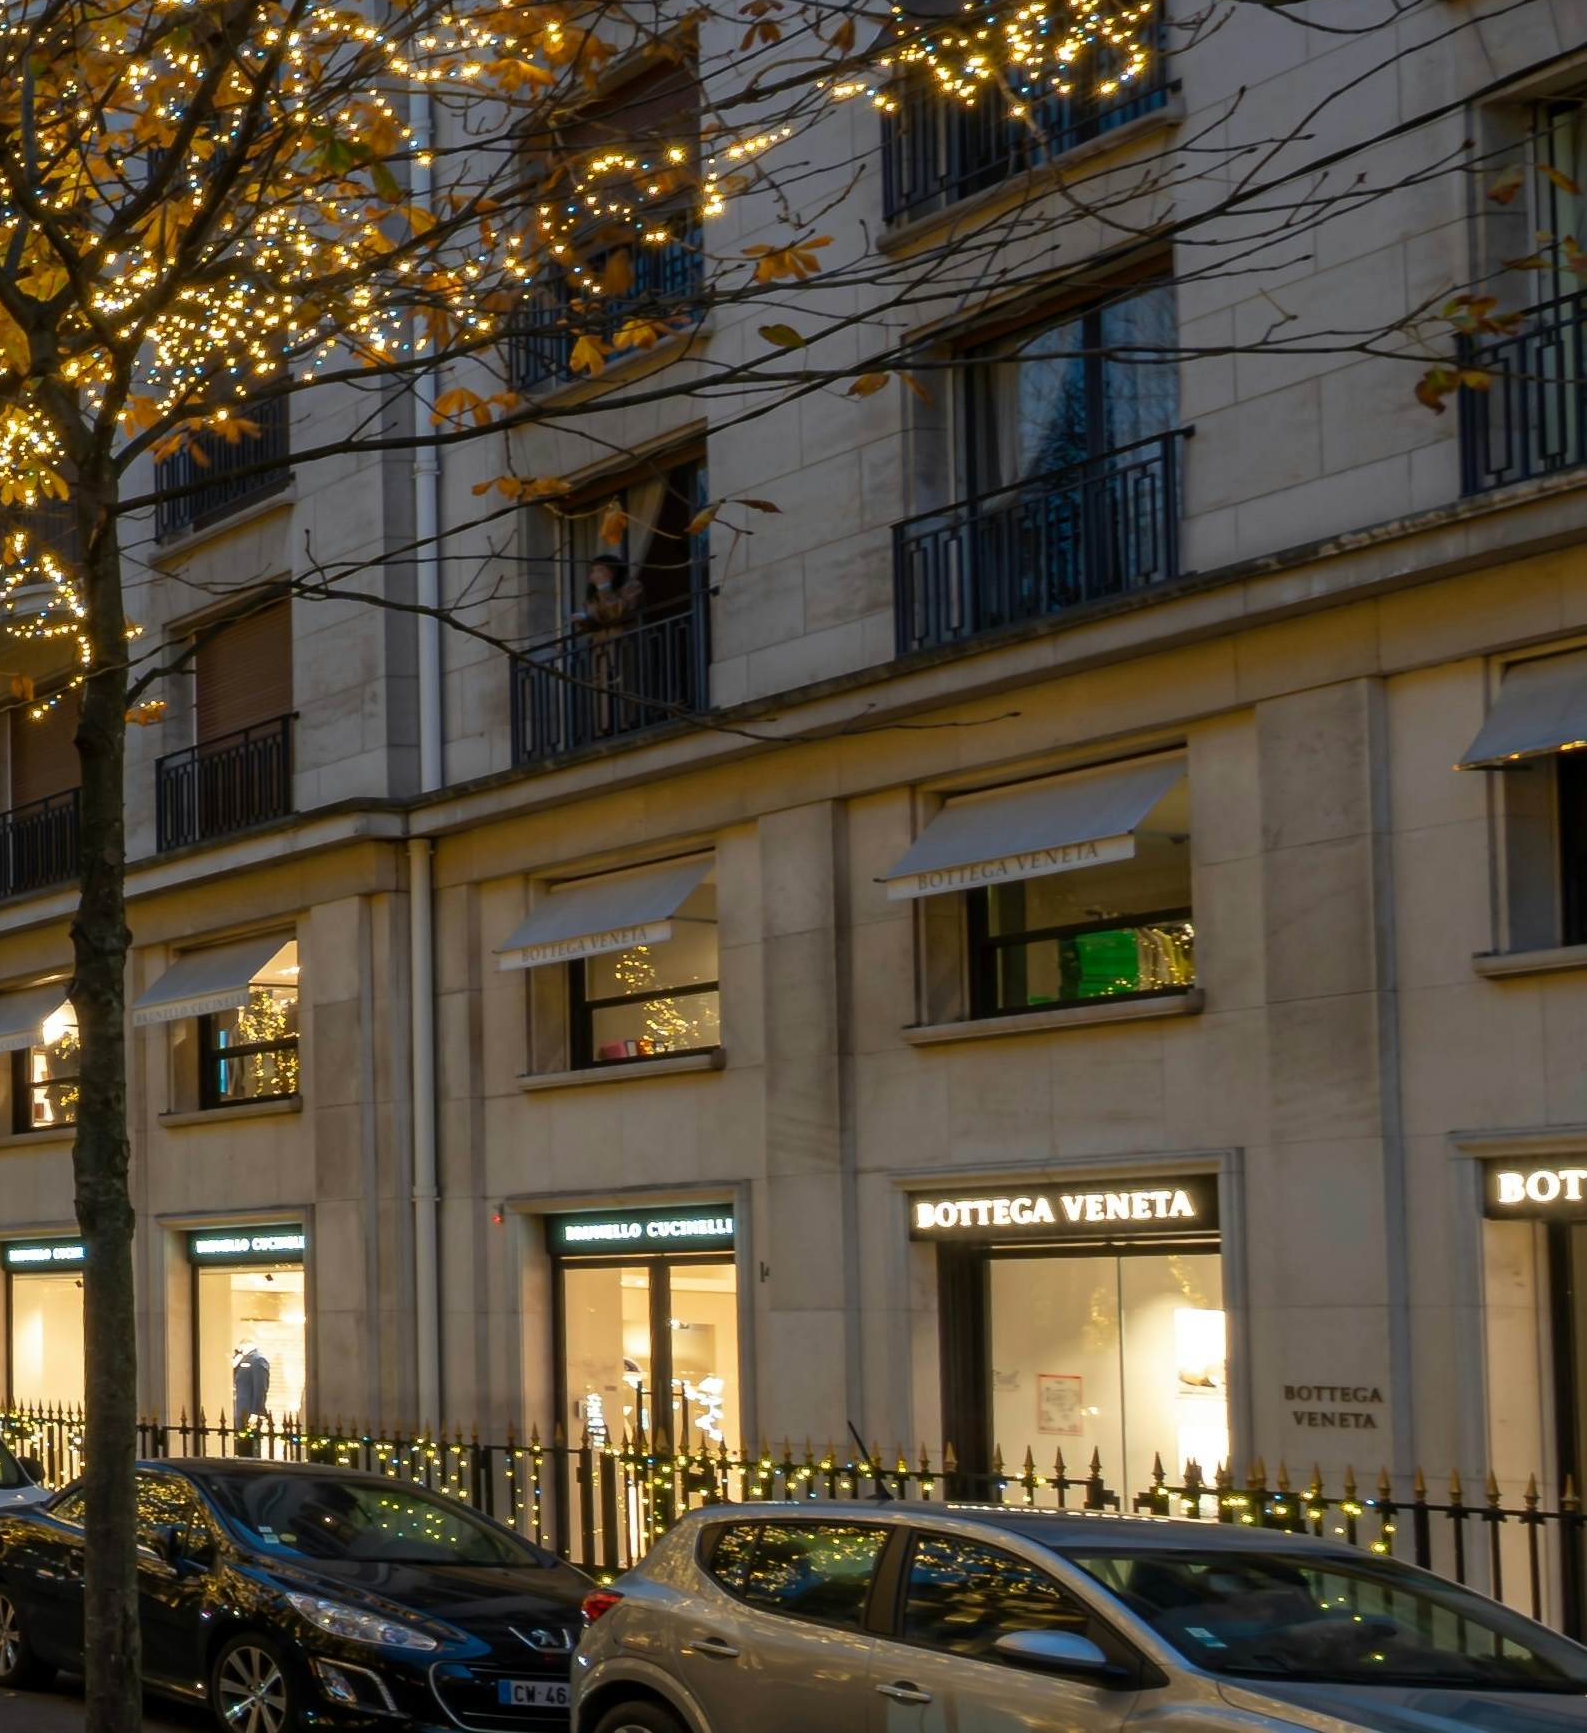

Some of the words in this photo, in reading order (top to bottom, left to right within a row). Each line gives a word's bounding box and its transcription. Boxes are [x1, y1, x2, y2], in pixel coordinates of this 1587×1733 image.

[918, 861, 1007, 891] BOTTEGA
[1017, 843, 1099, 871] VENETA
[521, 938, 586, 963] BOTTEGA
[590, 927, 647, 948] VENETA
[916, 1197, 1056, 1229] BOTTEGA
[1060, 1190, 1195, 1221] VENETA
[1284, 1385, 1384, 1403] BOTTEGA
[1293, 1410, 1378, 1429] VENETA
